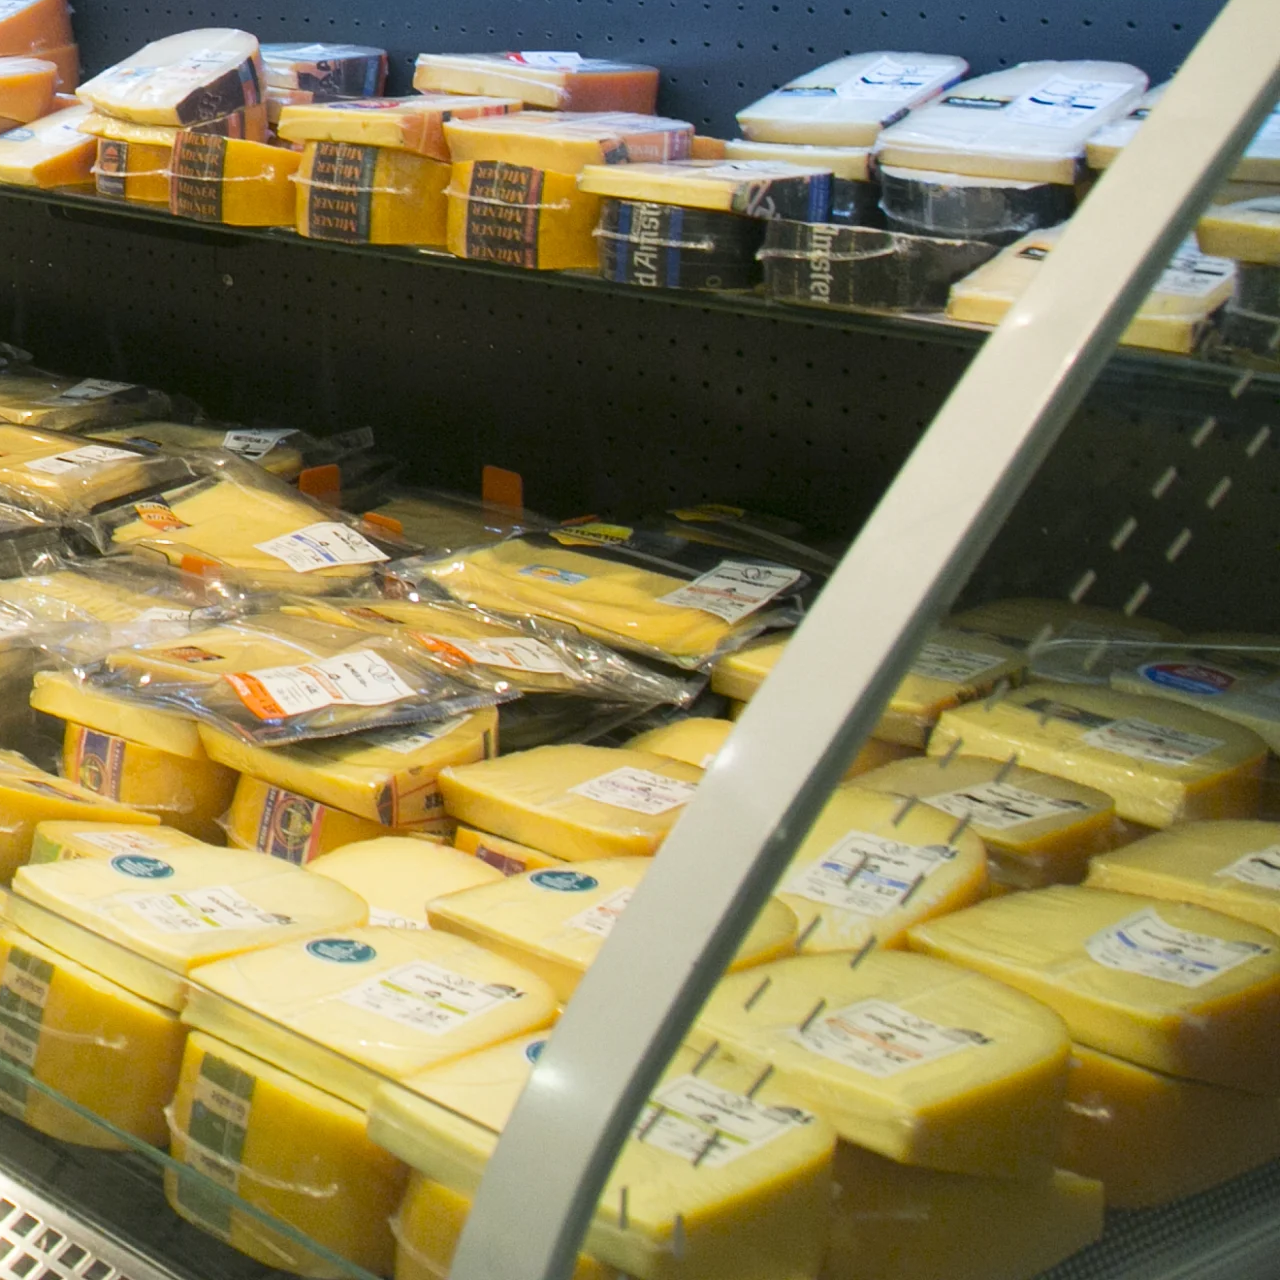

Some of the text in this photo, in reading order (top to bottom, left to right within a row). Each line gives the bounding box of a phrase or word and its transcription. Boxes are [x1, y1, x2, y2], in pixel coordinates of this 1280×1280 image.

[476, 167, 530, 186] MILNER
[177, 181, 217, 199] MILNER
[176, 198, 217, 216] MILNER
[313, 196, 358, 215] MILNER
[472, 203, 523, 223] MILNER
[312, 214, 357, 233] MILNER
[471, 222, 522, 242] MILNER
[471, 244, 523, 264] MILNER
